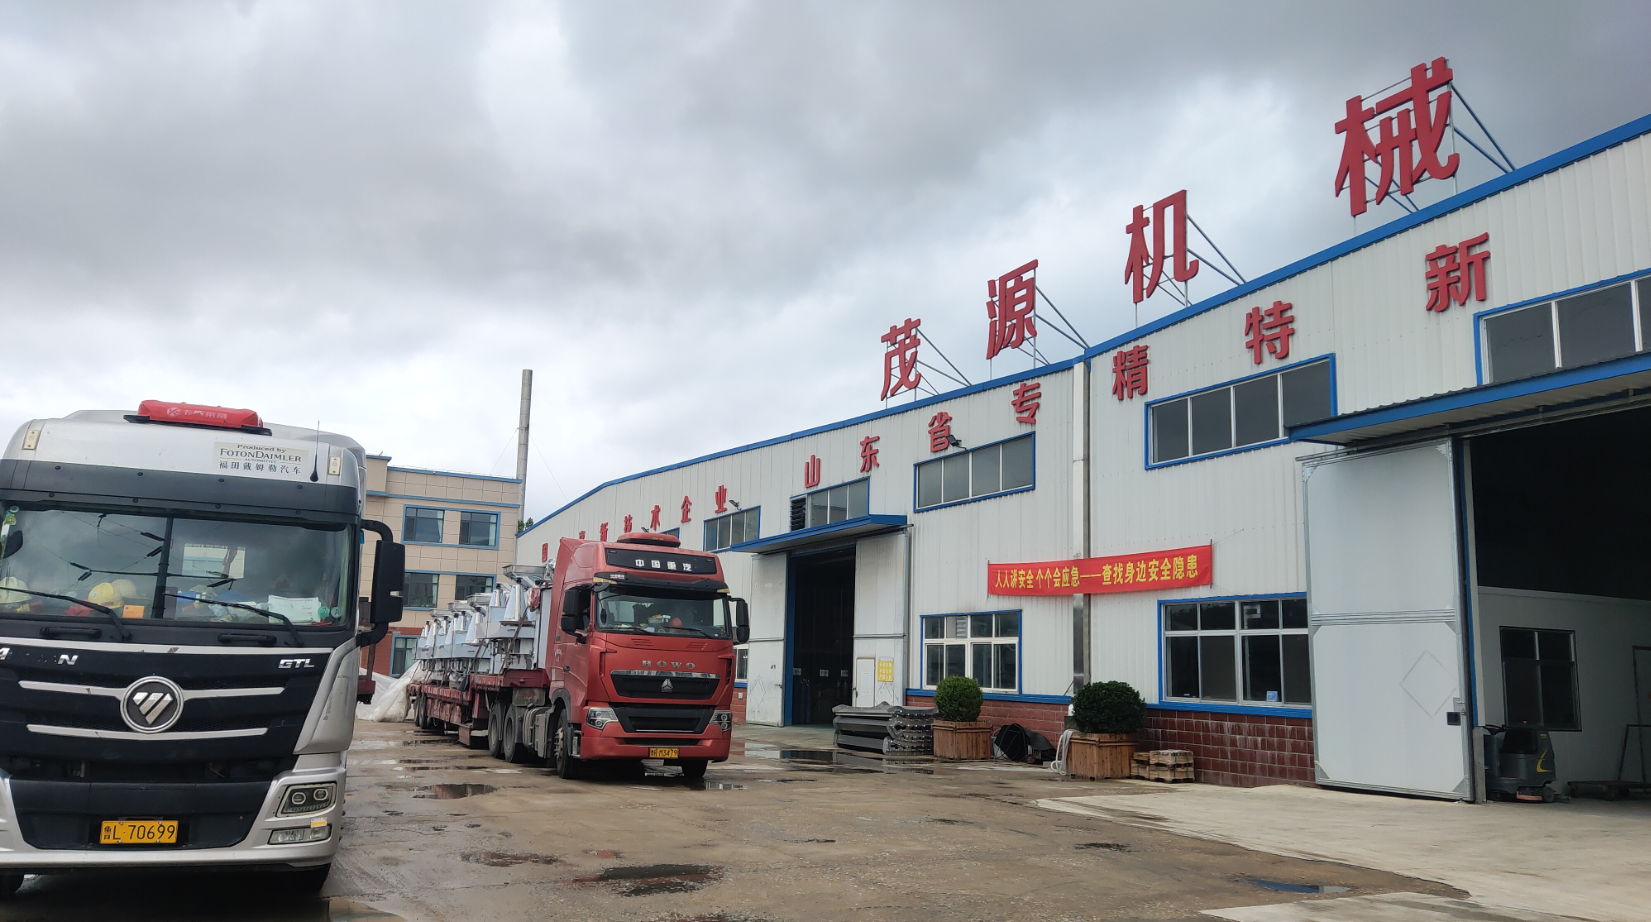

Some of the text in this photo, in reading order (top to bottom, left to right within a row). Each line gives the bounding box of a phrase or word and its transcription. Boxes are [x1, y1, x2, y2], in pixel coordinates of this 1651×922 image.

[880, 56, 1460, 400] 茂源机械
[220, 448, 302, 462] FOTONDAIMLER
[237, 444, 275, 452] Produced
[220, 460, 301, 475] 福田戴姆勒汽车
[634, 558, 692, 572] 中国重汽
[278, 658, 315, 669] GTL
[641, 660, 696, 670] HOWO
